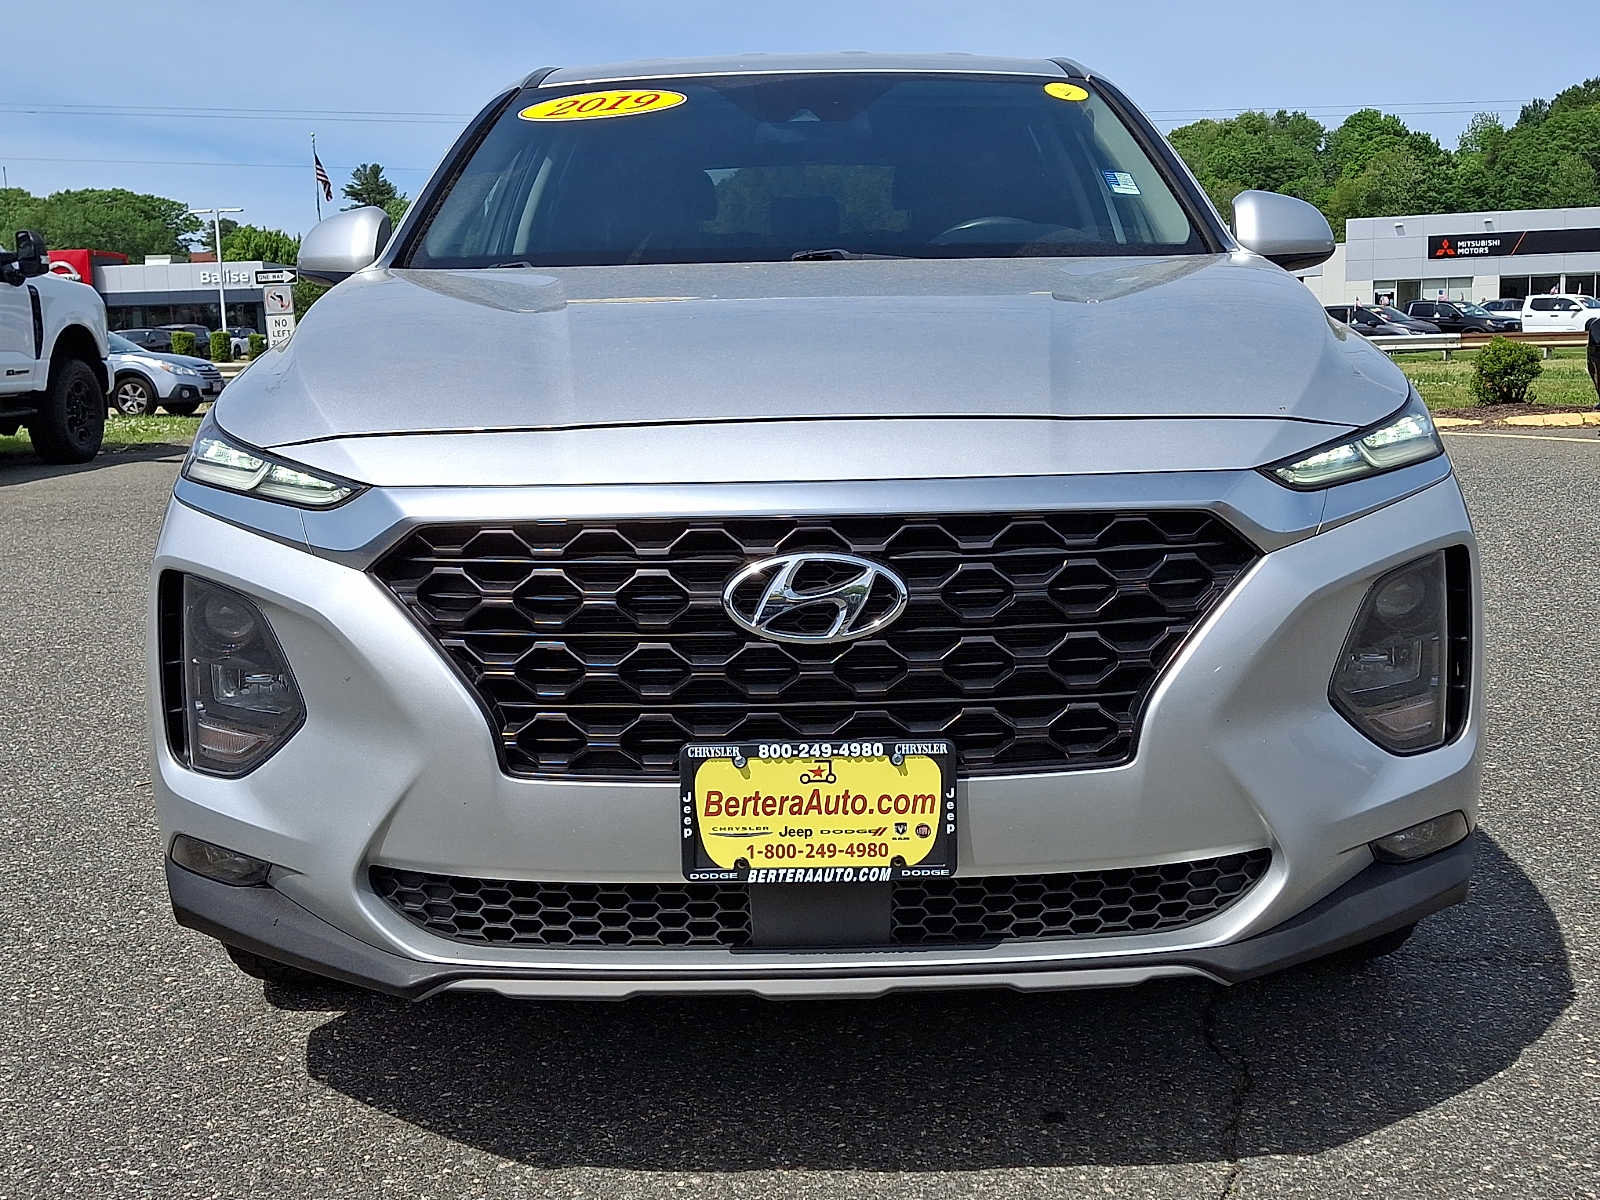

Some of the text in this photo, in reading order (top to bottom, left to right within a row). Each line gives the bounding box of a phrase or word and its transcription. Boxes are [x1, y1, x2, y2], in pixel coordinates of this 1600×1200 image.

[544, 93, 661, 117] 2019
[1457, 247, 1489, 255] MOTORS
[199, 269, 249, 283] Balise
[275, 319, 288, 327] NO
[687, 747, 740, 758] CHRYSLER
[758, 743, 884, 758] 800-249-4980
[895, 743, 948, 755] CHRYSLER
[704, 788, 936, 817] BerteraAuto.com
[682, 792, 693, 838] Jeep
[945, 787, 956, 834] Jeep
[779, 826, 813, 839] Jeep
[746, 843, 889, 859] 1-800-249-4980
[690, 872, 738, 880] DODGE
[747, 867, 892, 883] BERTERAAUTO.COM
[901, 869, 950, 877] DODGE
